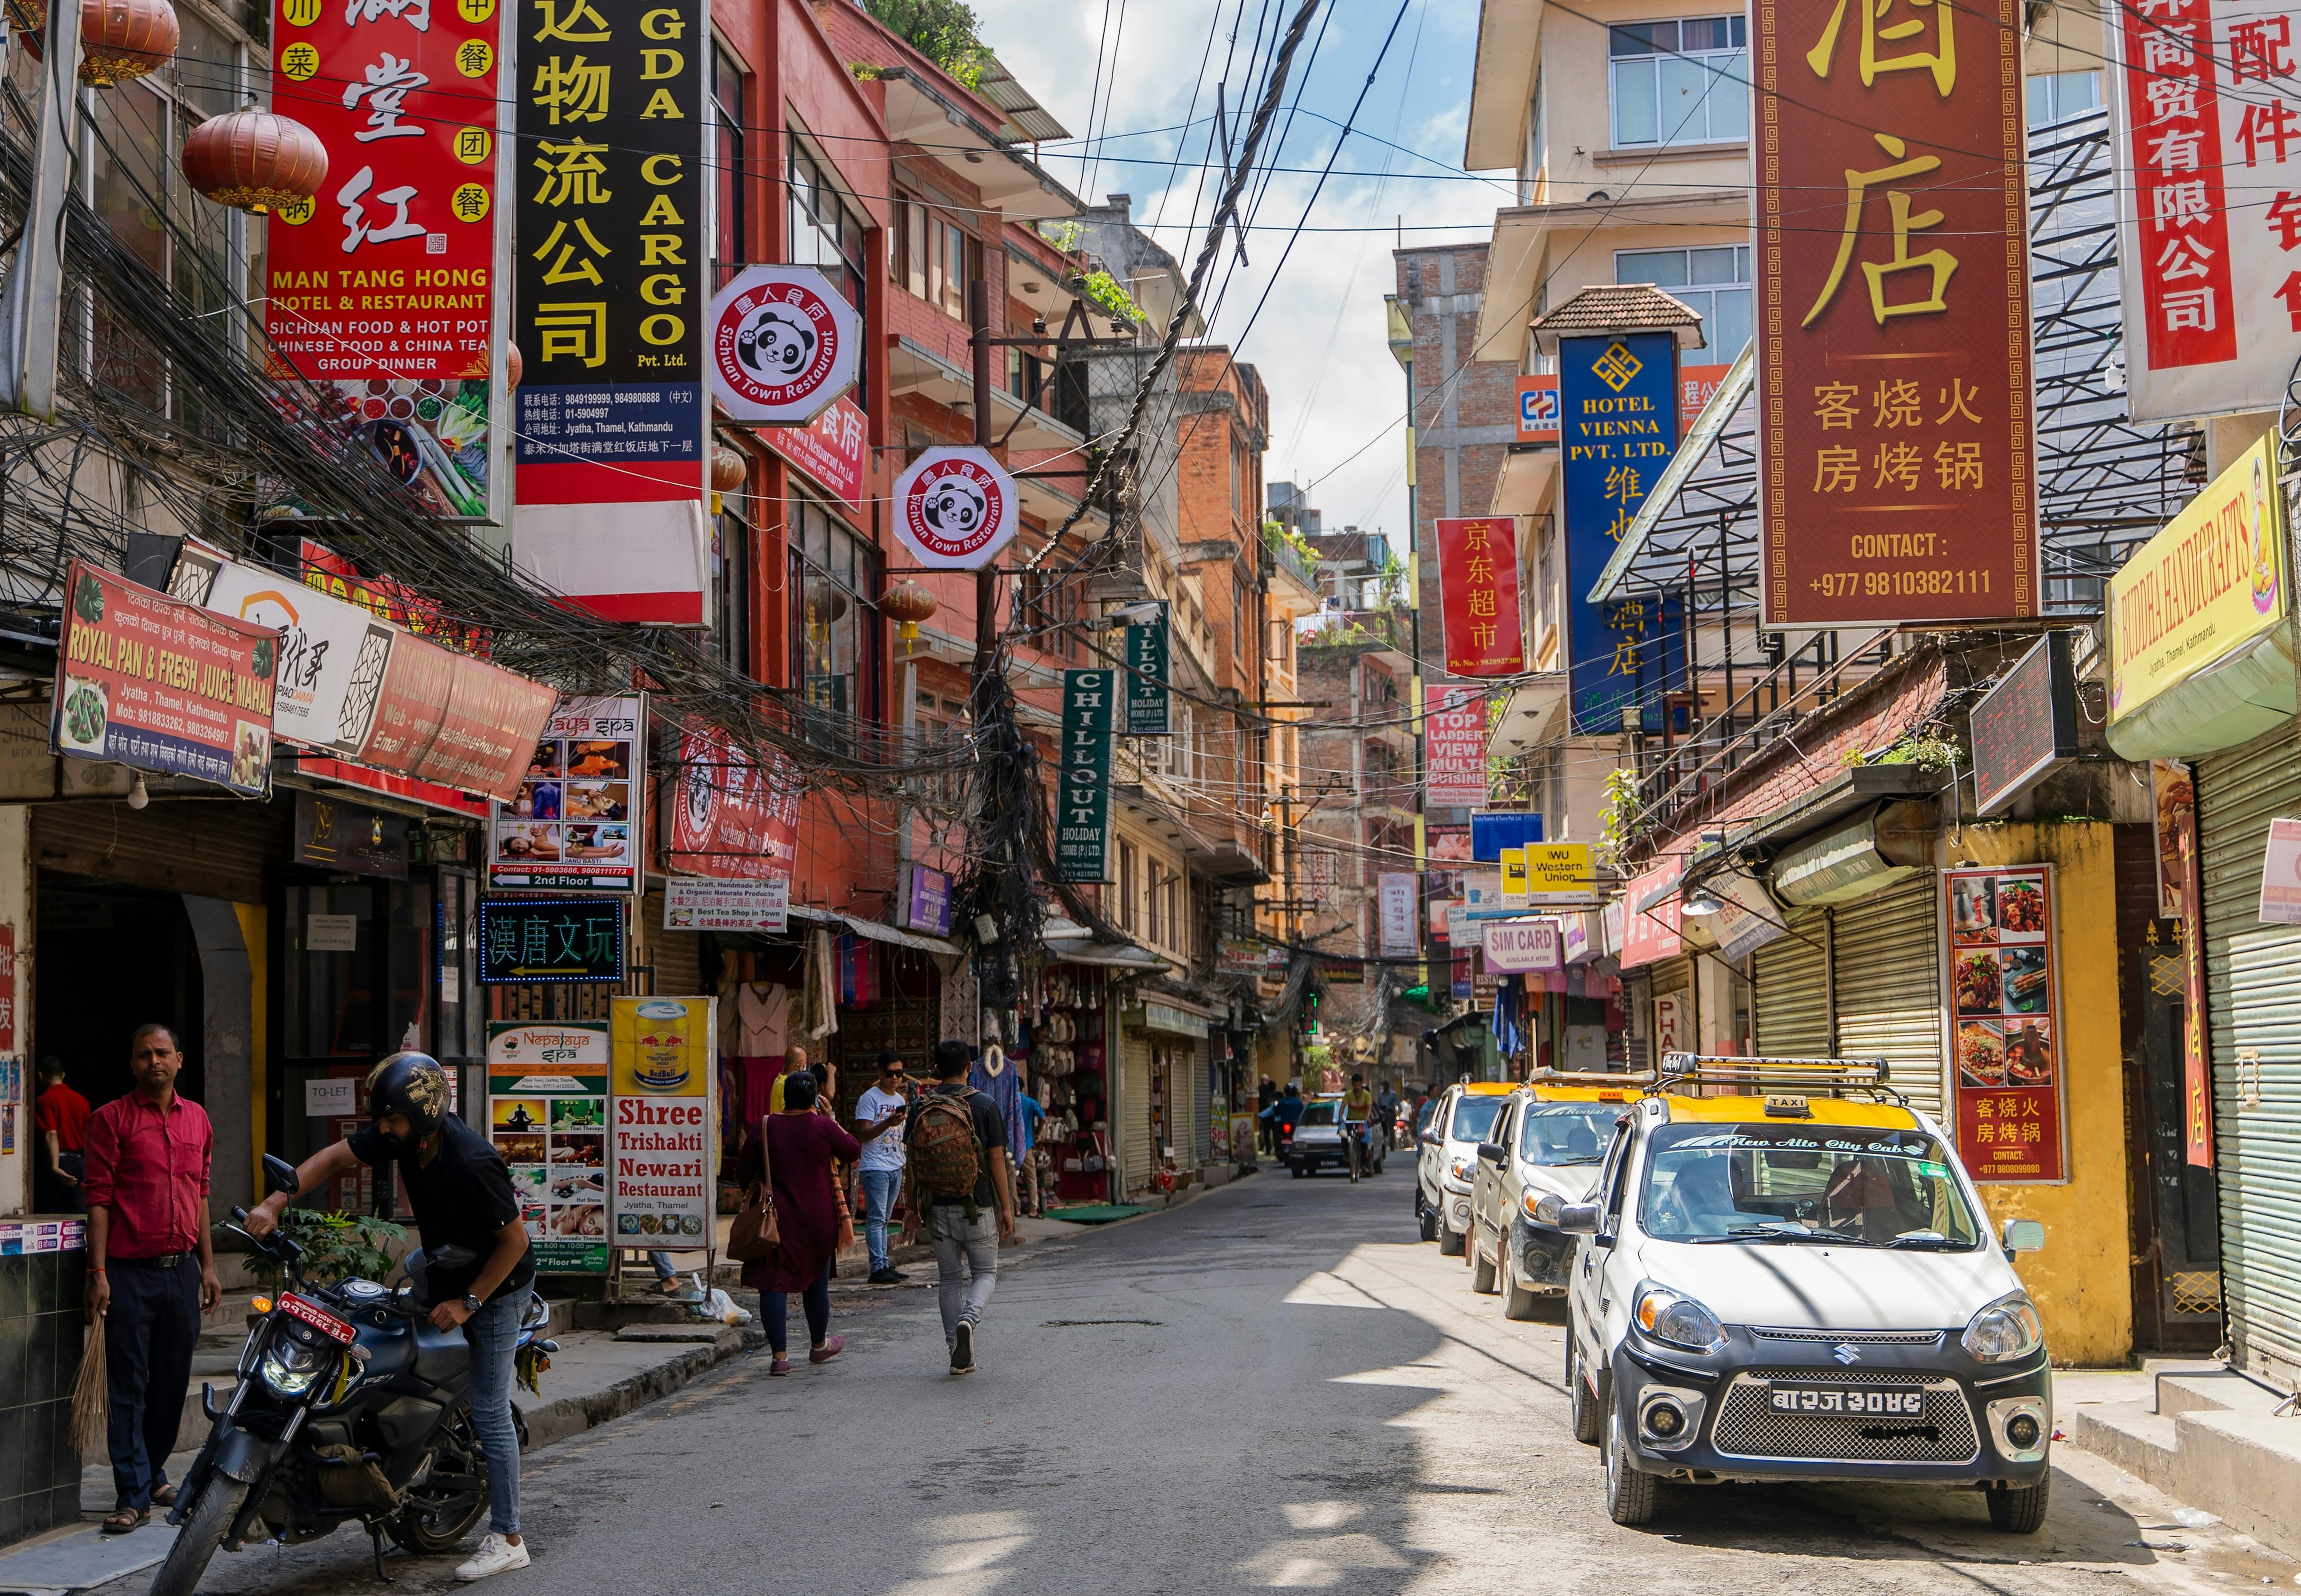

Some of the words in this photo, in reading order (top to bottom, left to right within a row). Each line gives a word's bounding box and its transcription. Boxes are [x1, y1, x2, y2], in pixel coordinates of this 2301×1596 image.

[639, 9, 686, 119] GDA
[639, 154, 686, 345] CARGO
[273, 272, 328, 288] MAN
[339, 270, 404, 288] TANG
[416, 269, 486, 286] HONG
[273, 296, 332, 310] HOTEL
[340, 297, 354, 309] &
[362, 295, 485, 309] RESTAURANT
[270, 321, 342, 335] SICHUAN
[349, 321, 394, 334] FOOD
[401, 321, 411, 333] &
[417, 321, 450, 333] HOT
[457, 320, 487, 332] POT
[268, 341, 334, 352] CHINESE
[341, 341, 383, 351] FOOD
[390, 341, 399, 351] &
[405, 340, 453, 351] CHINA
[459, 339, 488, 350] TEA
[318, 359, 373, 370] GROUP
[379, 358, 437, 369] DINNER
[638, 355, 660, 366] Pvt.
[664, 354, 686, 366] Ltd.
[719, 324, 741, 382] Sichuan
[742, 378, 781, 400] Town
[785, 330, 833, 398] Restaurant
[1583, 396, 1655, 414] HOTEL
[566, 408, 609, 419] 01-5904997
[566, 423, 594, 435] Jyatha,
[595, 423, 626, 434] Thamel,
[628, 421, 673, 433] Kathmandu
[1580, 420, 1660, 436] VIENNA
[1570, 445, 1616, 461] PVT.
[1625, 442, 1671, 457] LTD.
[910, 493, 929, 540] Sichuan
[929, 535, 960, 553] Town
[963, 495, 999, 551] Restaurant
[1809, 573, 1859, 597] +977
[1865, 570, 1990, 596] 9810382111
[2122, 564, 2164, 665] BUDDHA
[2163, 491, 2250, 636] HANDICRAFTS
[1464, 522, 1498, 652] 京东超市
[2149, 656, 2165, 677] Jyatha,
[2166, 644, 2185, 666] Thamel,
[2186, 622, 2216, 657] Kathmandu
[69, 623, 114, 670] ROYAL
[117, 637, 144, 677] PAN
[146, 645, 155, 683] &
[158, 650, 199, 694] FRESH
[200, 663, 235, 705] JUICE
[237, 675, 271, 718] MAHAL
[121, 684, 148, 702] Jyatha
[155, 691, 184, 712] Thamel,
[187, 698, 228, 724] Kathmandu
[1132, 699, 1164, 708] HOLIDAY
[116, 703, 137, 720] Mob:
[138, 709, 184, 735] 9818833262,
[187, 720, 228, 744] 9803264907
[1435, 714, 1479, 728] TOP
[1431, 730, 1483, 741] LADDER
[1434, 743, 1479, 757] VIEW
[1431, 758, 1484, 771] MULTI
[1428, 772, 1484, 785] CUISINE
[1062, 828, 1101, 840] HOLIDAY
[1536, 862, 1582, 871] Western
[534, 876, 556, 885] 2nd
[559, 877, 588, 885] Floor
[1545, 872, 1575, 882] Union
[1492, 930, 1514, 952] SIM
[1518, 929, 1552, 951] CARD
[312, 1087, 347, 1096] TO-LET
[619, 1099, 703, 1126] Shree
[618, 1132, 703, 1151] Trishakti
[1776, 1138, 1819, 1148] Alto
[1825, 1140, 1863, 1151] City
[1868, 1142, 1903, 1154] Cab
[1993, 1150, 2024, 1160] CONTACT:
[618, 1158, 703, 1177] Newari
[1978, 1165, 1995, 1175] +977
[618, 1181, 703, 1197] Restaurant
[624, 1202, 655, 1210] Jyatha,
